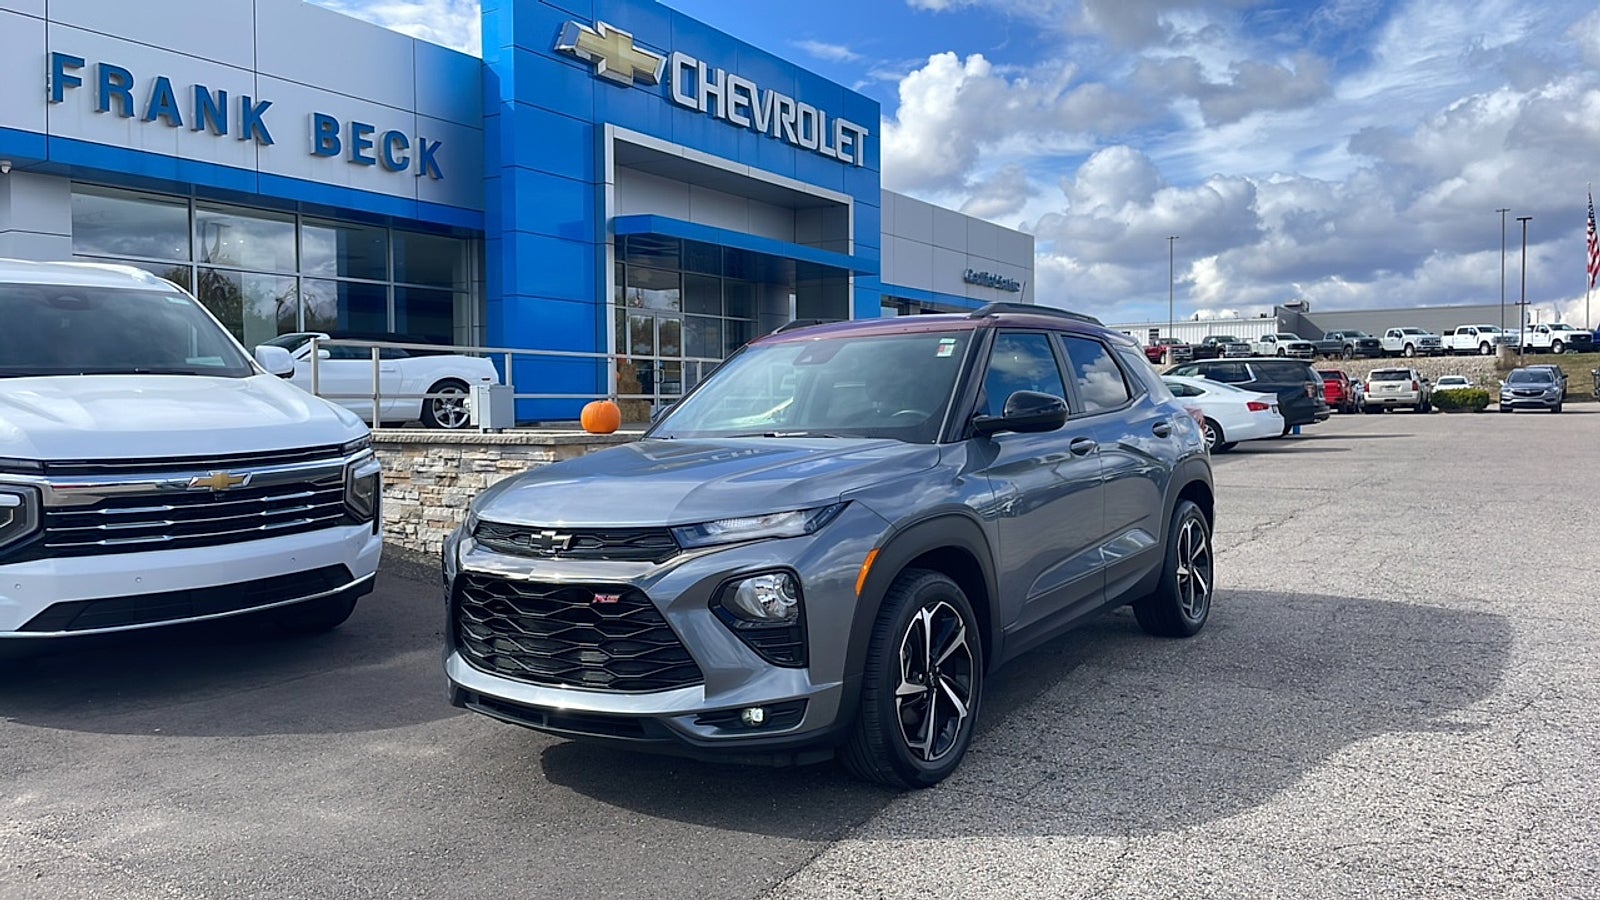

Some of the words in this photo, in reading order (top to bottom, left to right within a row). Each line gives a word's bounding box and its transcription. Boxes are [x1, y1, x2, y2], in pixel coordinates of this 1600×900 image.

[48, 51, 275, 146] FRANK
[309, 112, 445, 180] BECK
[669, 51, 869, 167] CHEVROLET
